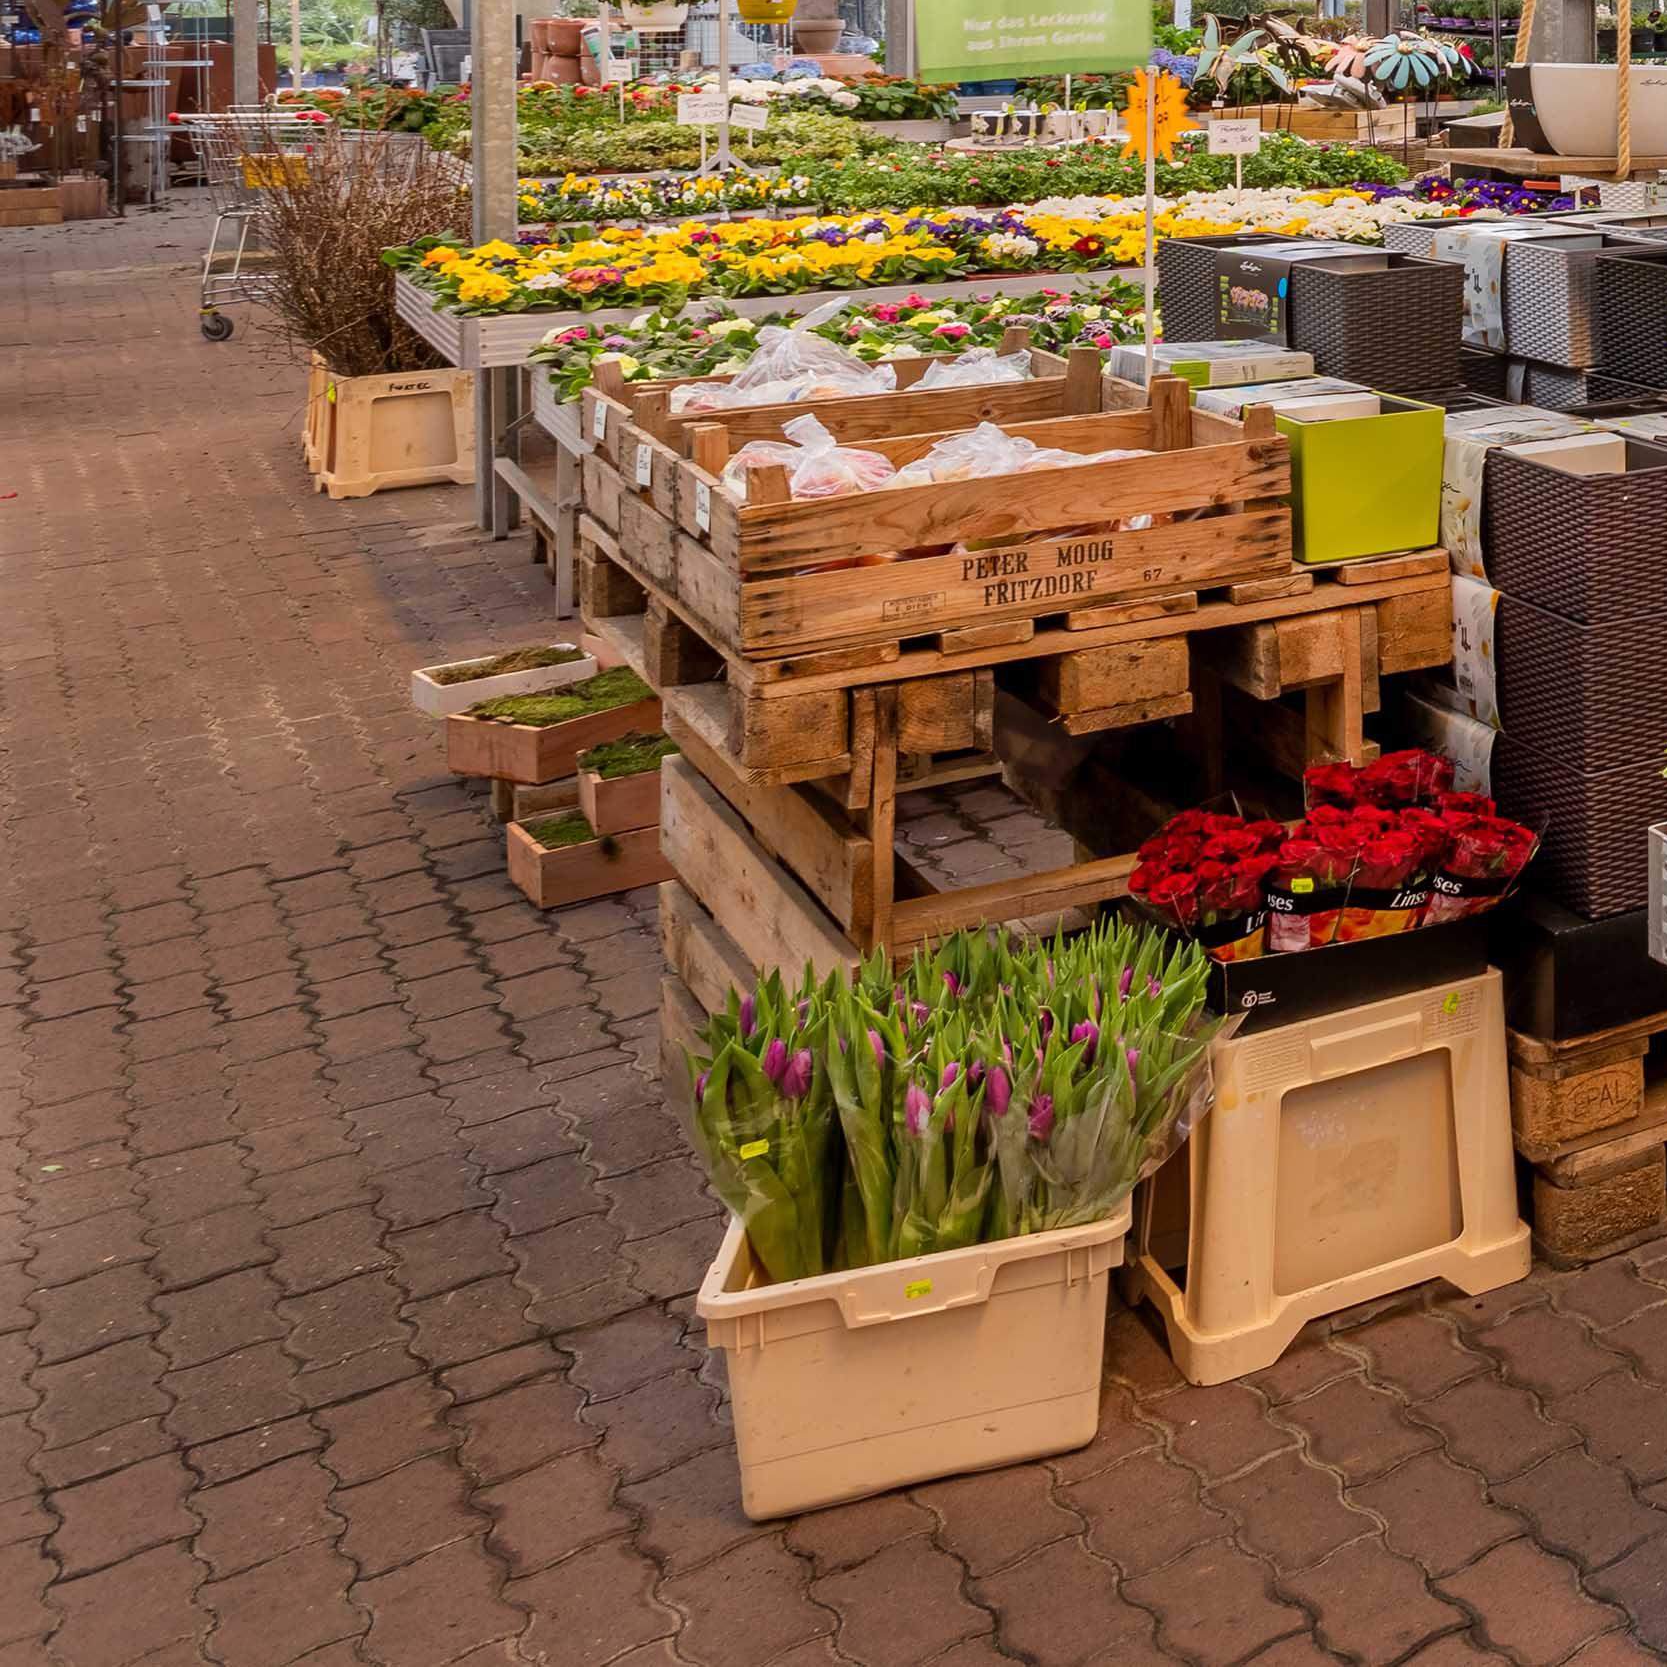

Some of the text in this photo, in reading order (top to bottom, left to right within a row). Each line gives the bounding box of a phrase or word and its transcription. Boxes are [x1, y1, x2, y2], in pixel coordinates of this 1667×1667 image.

[962, 540, 1114, 581] PETER MOOG
[983, 568, 1163, 607] FRITZDORF 67
